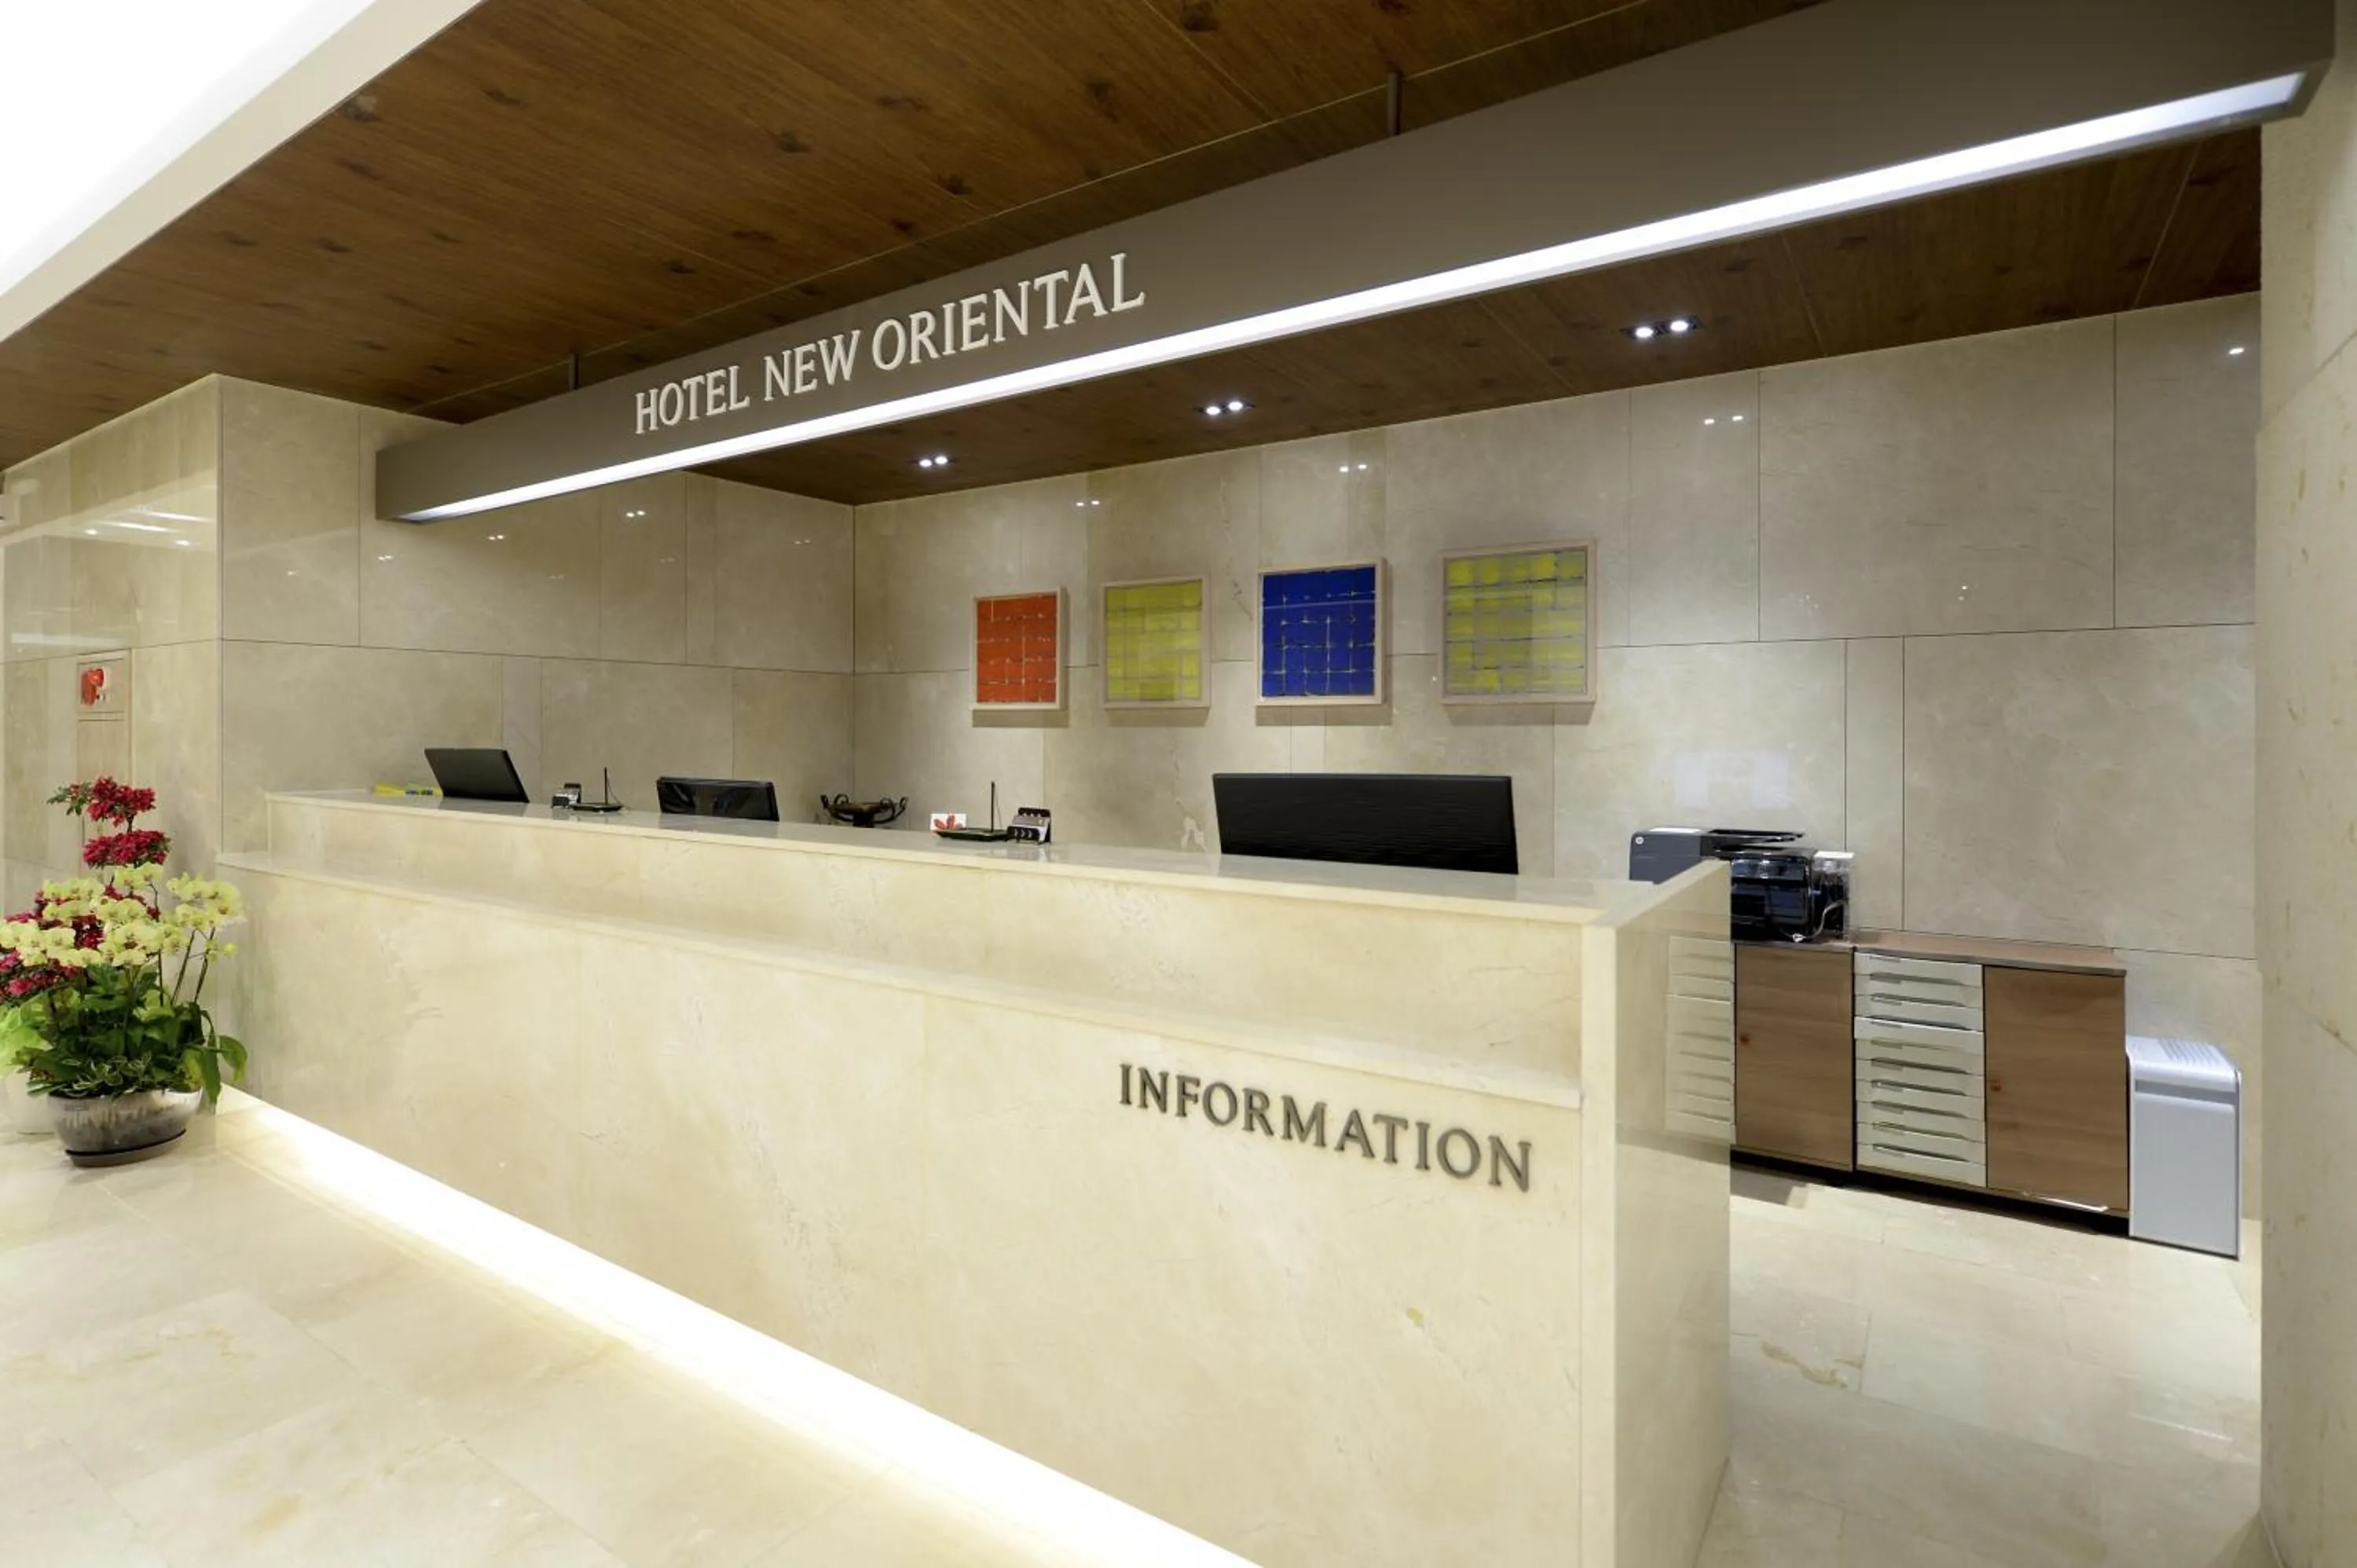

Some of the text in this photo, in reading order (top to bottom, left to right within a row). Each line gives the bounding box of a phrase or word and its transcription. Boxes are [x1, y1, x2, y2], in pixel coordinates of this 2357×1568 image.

[634, 253, 1145, 434] HOTEL NEW ORIENTAL
[1119, 1064, 1532, 1192] INFORMATION
